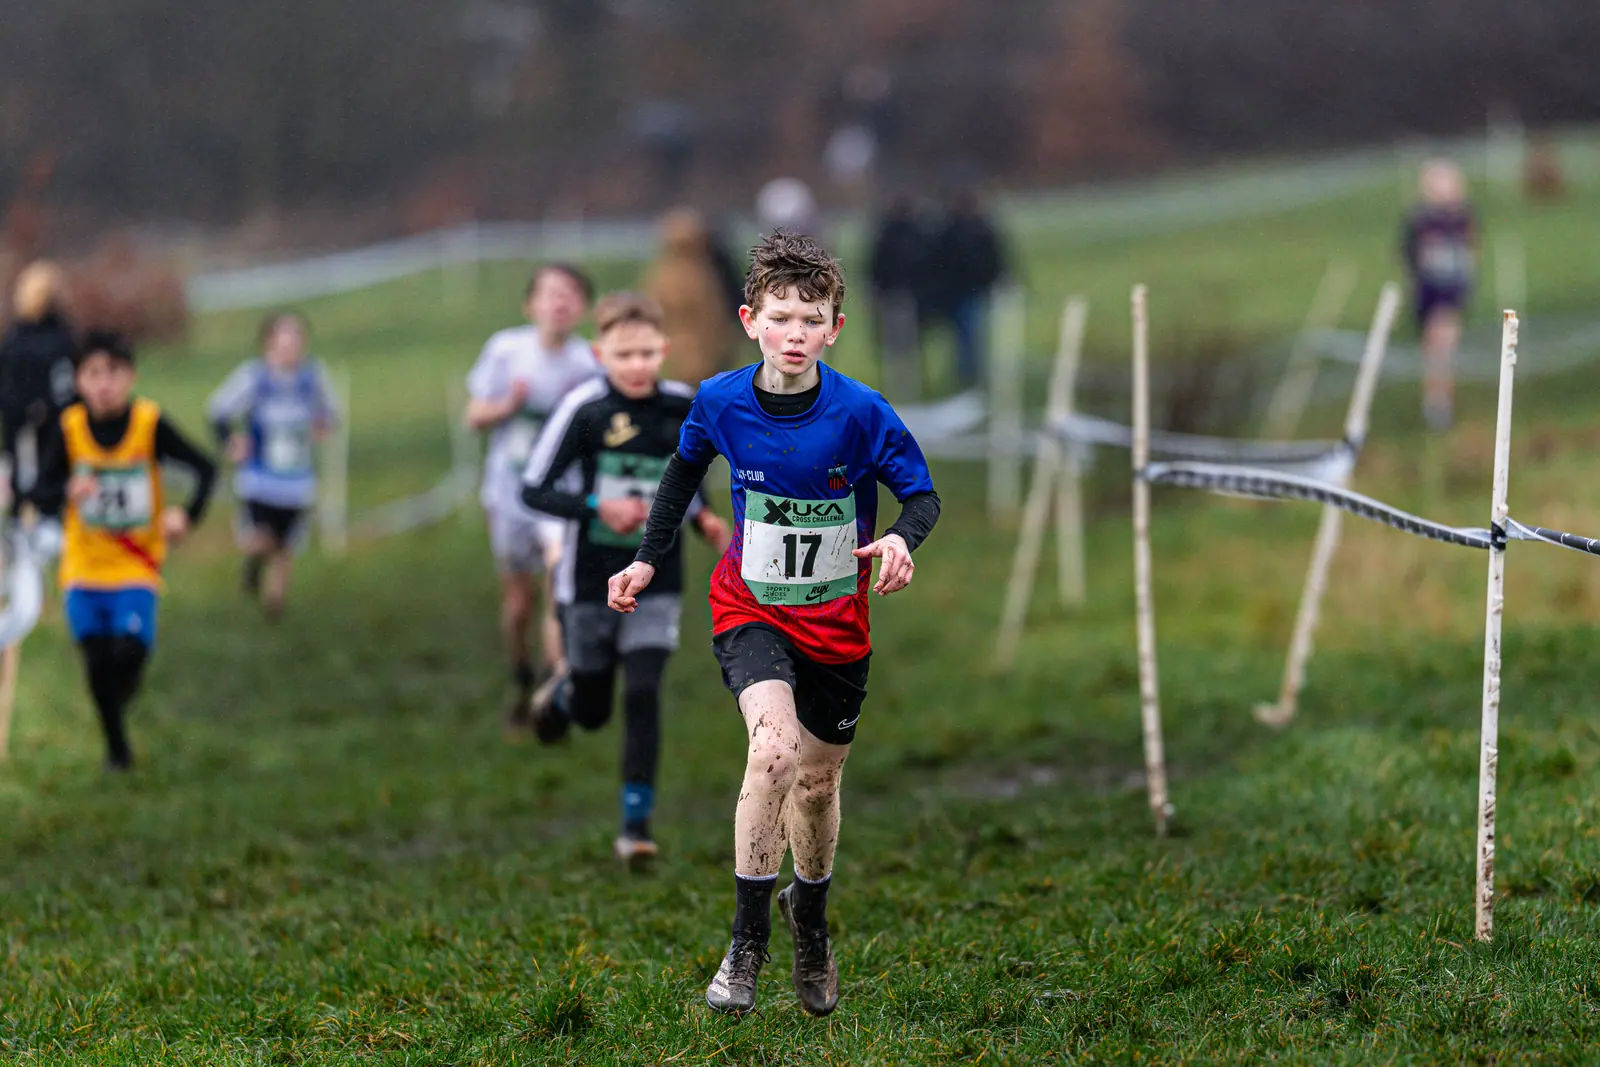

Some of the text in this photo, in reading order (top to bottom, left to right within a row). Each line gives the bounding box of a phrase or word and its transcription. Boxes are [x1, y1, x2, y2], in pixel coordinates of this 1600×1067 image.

[792, 514, 845, 523] CROSS CHALLENGE
[783, 534, 823, 578] 17
[810, 583, 830, 595] RUN
